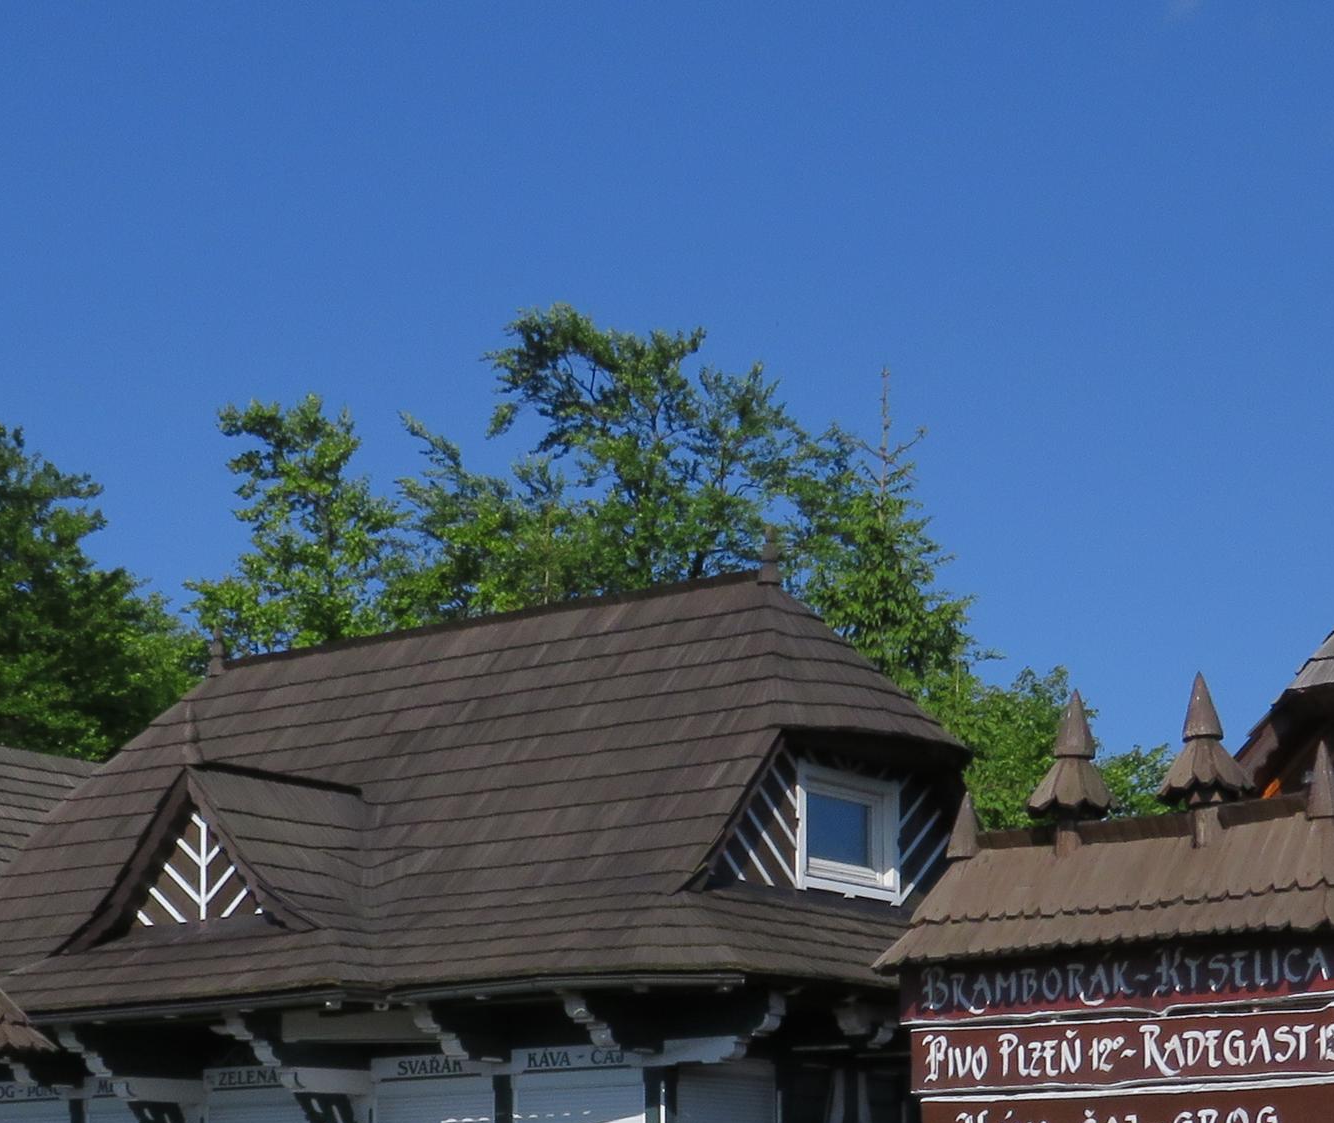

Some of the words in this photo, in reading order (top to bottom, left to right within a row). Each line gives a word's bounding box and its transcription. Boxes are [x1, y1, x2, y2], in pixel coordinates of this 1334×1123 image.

[921, 955, 1134, 1014] BRAMBORÁK
[1153, 947, 1332, 998] KYSELICA
[397, 1054, 464, 1075] SVAŘÁK
[526, 1048, 571, 1068] KÁVA
[922, 1033, 988, 1083] PIVO
[998, 1029, 1082, 1078] PLZEŇ
[1139, 1023, 1317, 1077] RADEGAST
